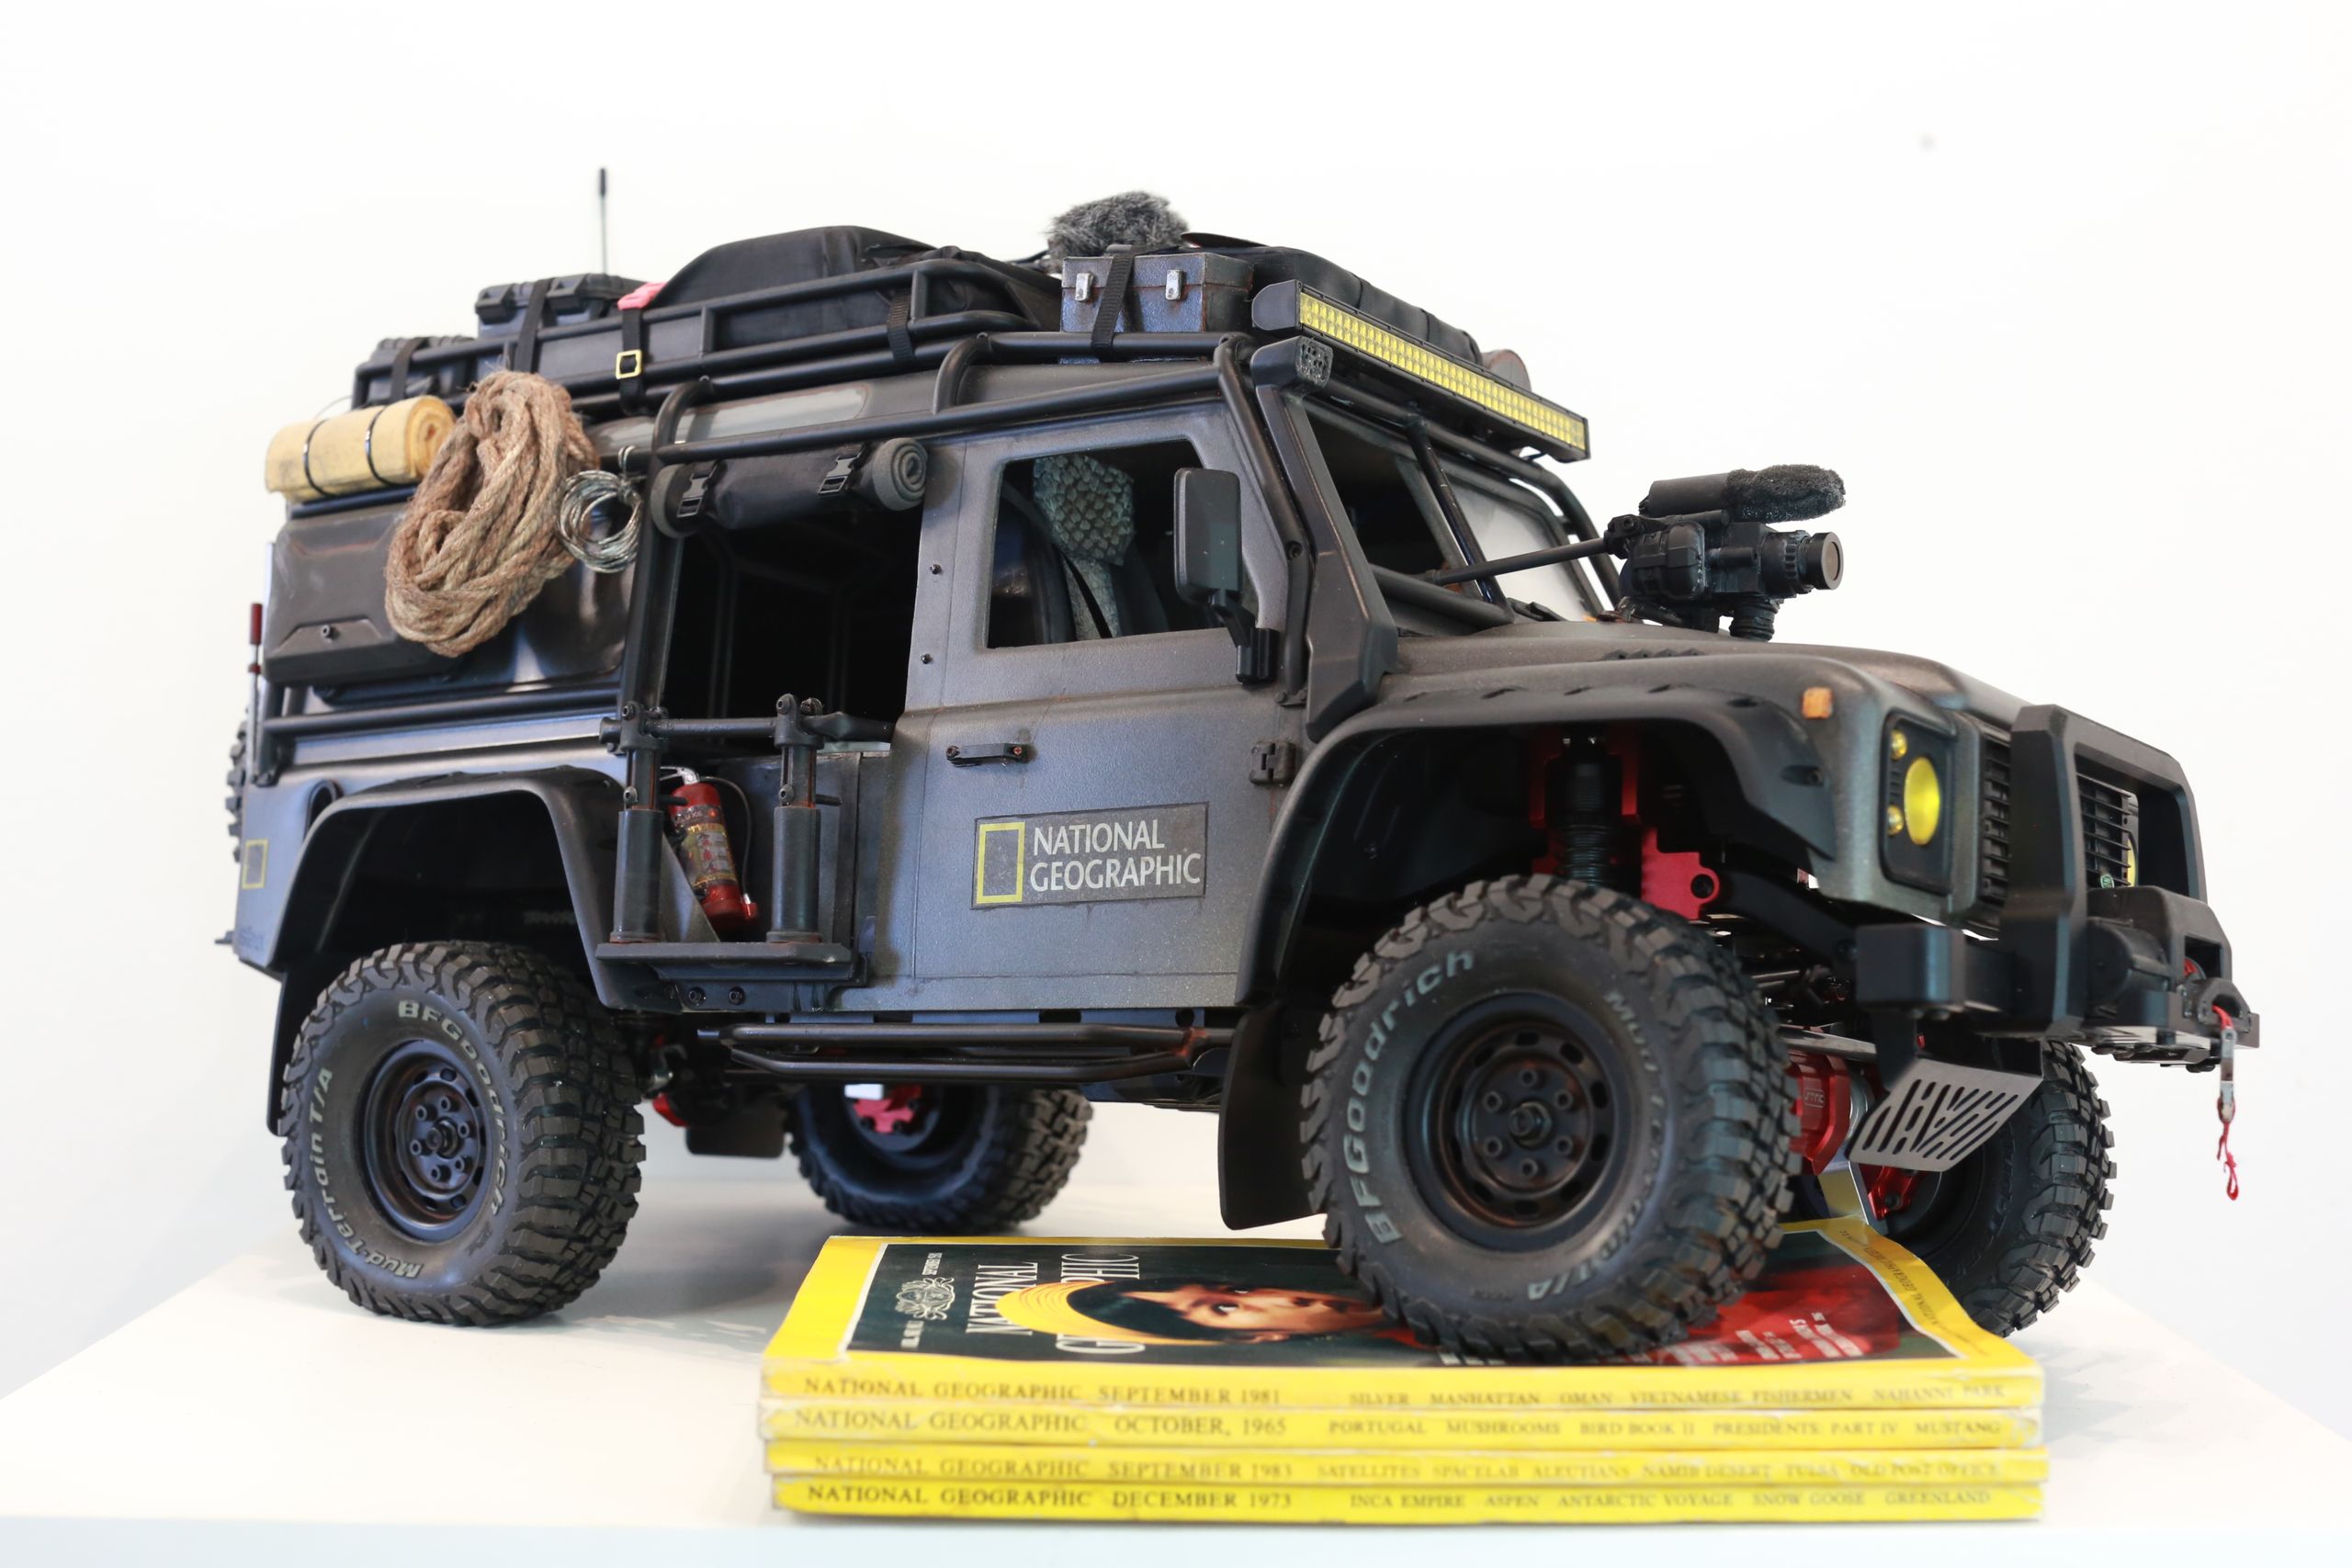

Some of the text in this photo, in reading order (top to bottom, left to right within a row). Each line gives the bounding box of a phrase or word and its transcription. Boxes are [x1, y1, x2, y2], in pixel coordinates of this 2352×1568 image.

[1034, 819, 1166, 856] NATIONAL
[1030, 852, 1202, 892] GEOGRAPHIC
[309, 1067, 334, 1124] T/A
[398, 999, 508, 1216] BFGoodrich
[1342, 950, 1476, 1245] BFGoodrich
[804, 1377, 1282, 1404] NATIONAL GEOGRAPHIC SEPTEMBER 1981
[1350, 1392, 1409, 1405] SILVER
[1429, 1392, 1541, 1405] MANHATTAN
[1559, 1391, 1613, 1404] OMAN
[1630, 1389, 1741, 1404] VIETNAMESE
[1752, 1388, 1853, 1403] FISHERMEN
[794, 1408, 1287, 1437] NATIONAL GEOGRAPHIC OCTOBER, 1965
[1329, 1420, 1426, 1435] PORTUGAL
[1446, 1420, 1561, 1435] MUSHROOMS
[1579, 1421, 1623, 1436] BIRD
[1628, 1421, 1676, 1436] BOOK
[1682, 1421, 1696, 1436] II
[1830, 1421, 1873, 1435] PART
[1880, 1421, 1900, 1435] IV
[1914, 1421, 2002, 1435] MUSTANG
[814, 1455, 928, 1474] NATIONAL
[939, 1458, 1090, 1478] GEOGRAPHIC
[1108, 1461, 1242, 1479] SEPTEMBER
[1317, 1464, 1421, 1479] SATELLITES
[808, 1483, 1294, 1509] NATIONAL GEOGRAPHIC DECEMBER 1973
[1351, 1490, 1992, 1508] INCA EMPIRE ASPEN ANTARCTIC VOYAGE SNOW GOOSE GREENLAND
